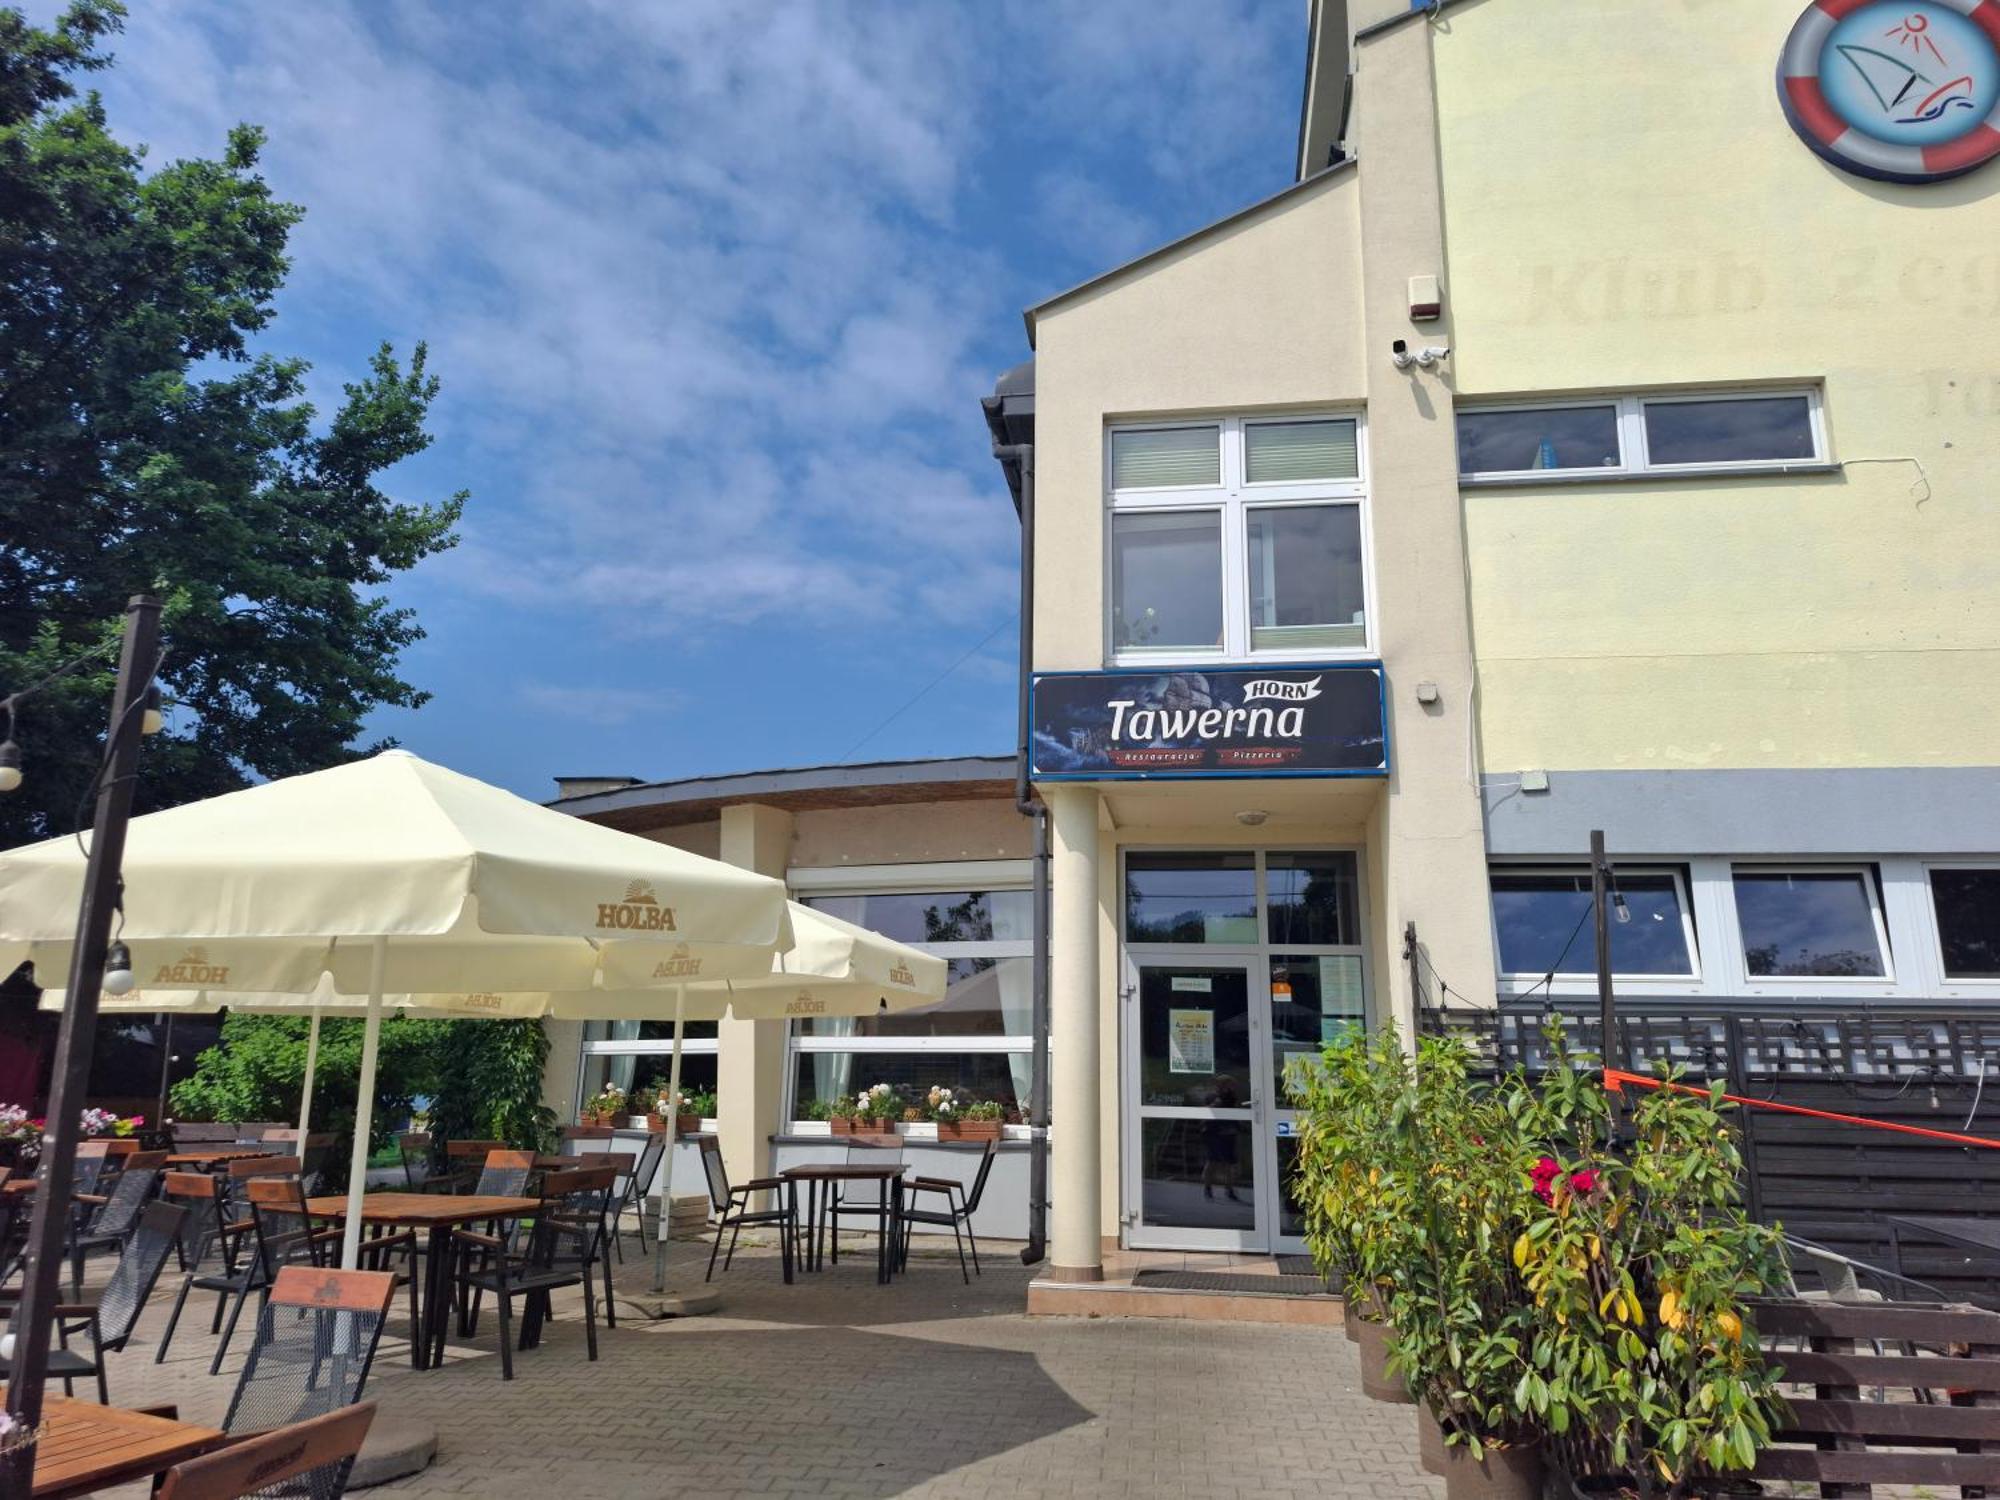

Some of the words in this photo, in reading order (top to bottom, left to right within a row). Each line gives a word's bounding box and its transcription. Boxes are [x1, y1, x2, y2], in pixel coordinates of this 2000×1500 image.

[1251, 681, 1309, 699] HORN
[1107, 699, 1306, 741] Tawerna
[1124, 752, 1196, 762] Restauracja
[1232, 750, 1283, 760] Pizzeria
[595, 903, 678, 931] HOLBA
